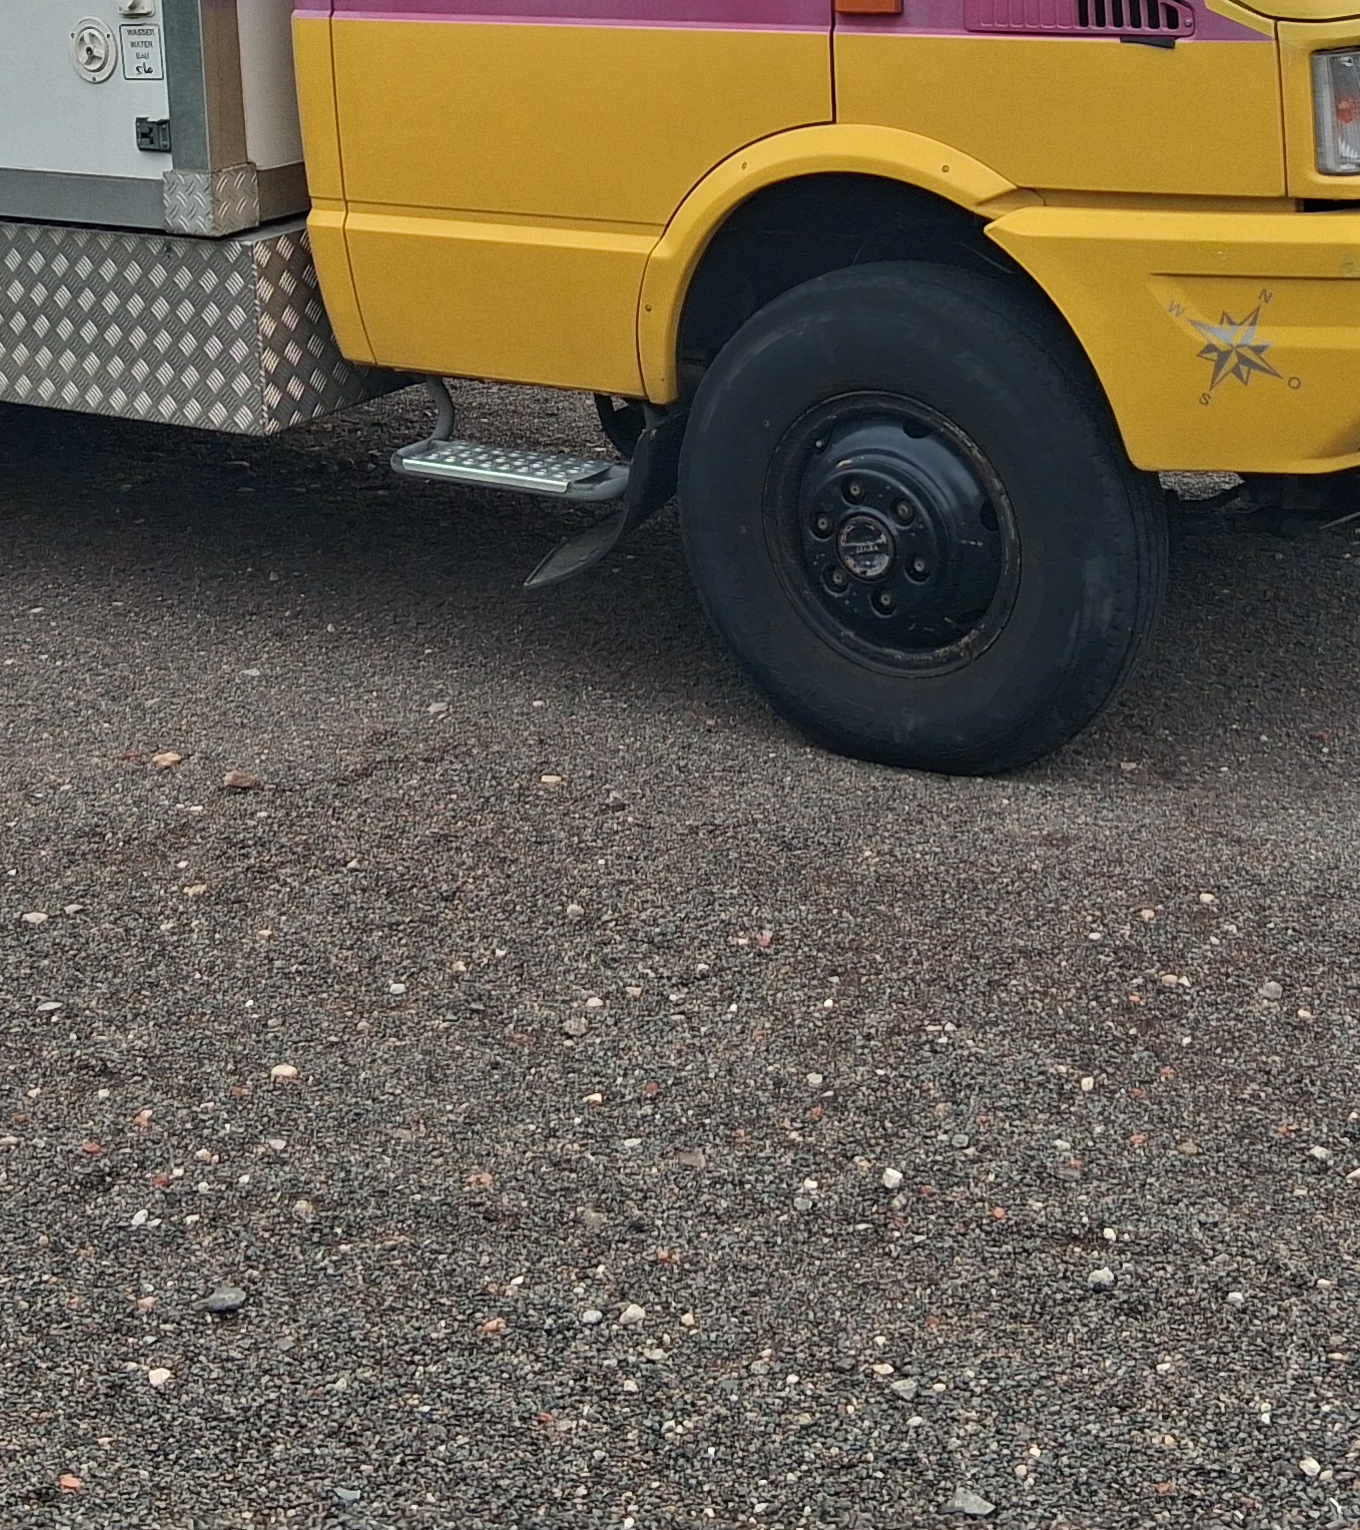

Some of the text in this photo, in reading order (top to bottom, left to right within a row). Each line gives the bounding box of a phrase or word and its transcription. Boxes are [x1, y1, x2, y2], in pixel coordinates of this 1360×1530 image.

[127, 28, 156, 36] WASSER
[130, 40, 154, 48] WATER
[1258, 288, 1273, 304] N
[1168, 300, 1185, 318] W
[1287, 376, 1302, 390] O
[1198, 392, 1212, 406] S
